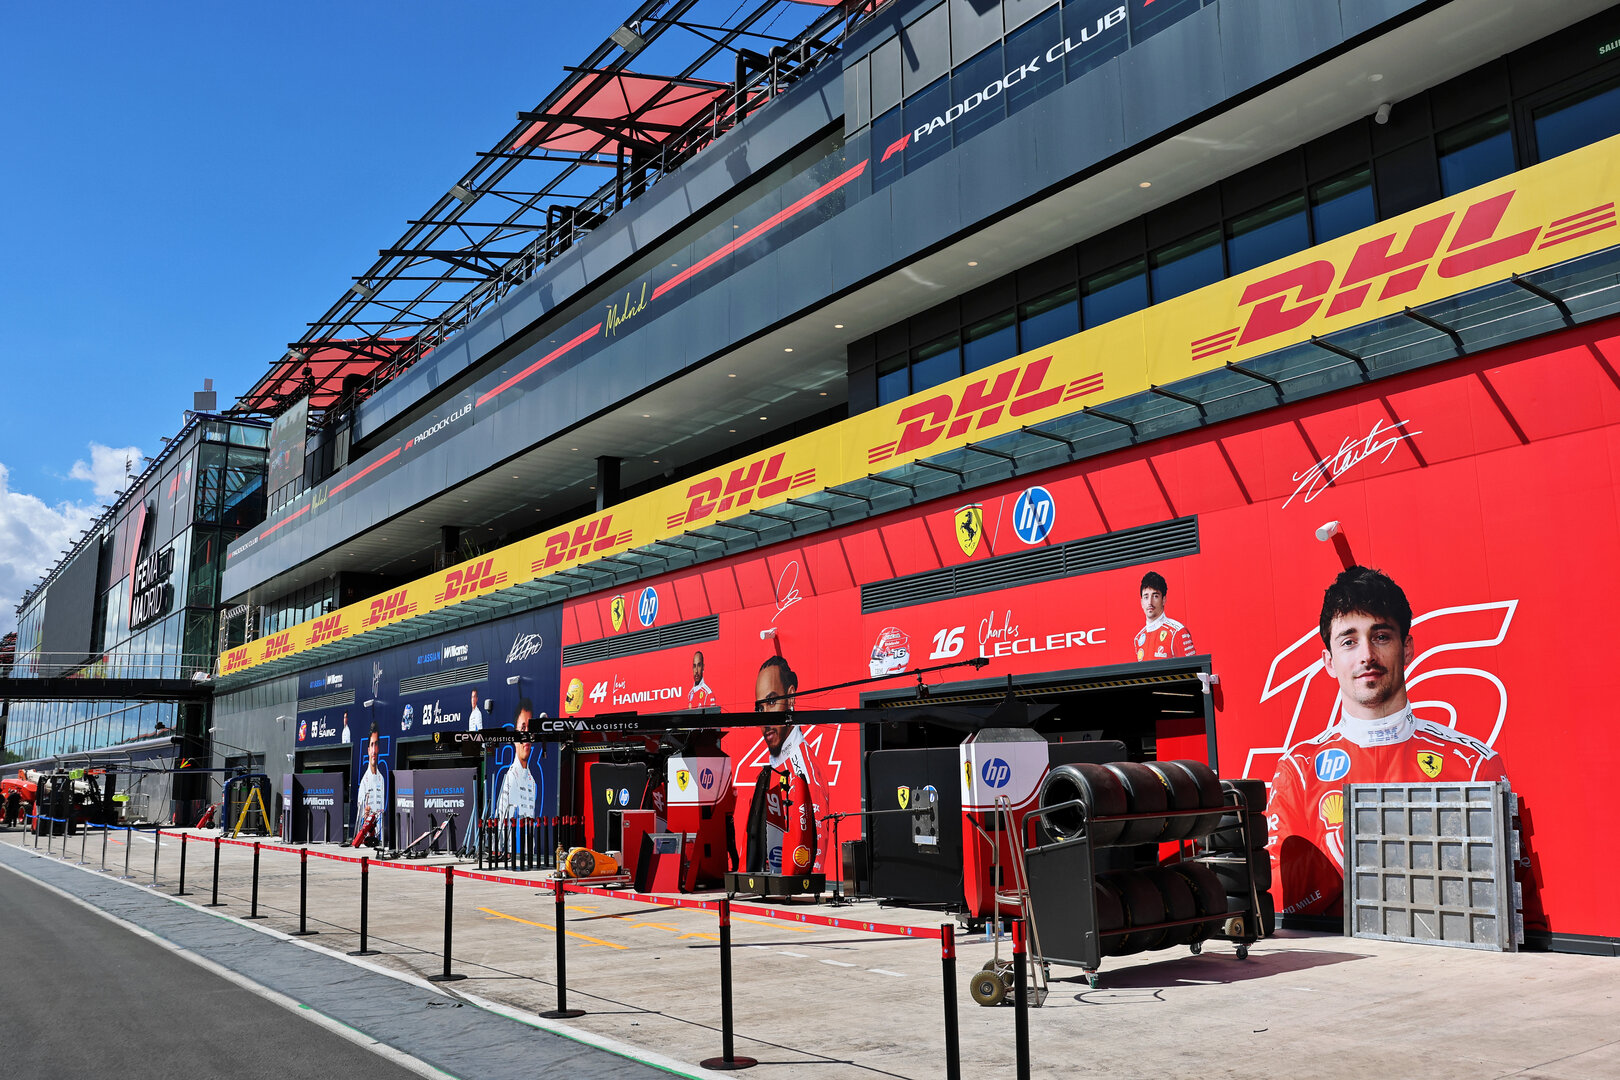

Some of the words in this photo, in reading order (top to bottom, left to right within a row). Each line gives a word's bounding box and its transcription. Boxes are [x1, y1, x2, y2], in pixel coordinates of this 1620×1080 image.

[1599, 39, 1620, 54] SALI
[914, 56, 1040, 143] PADDOCK
[1045, 5, 1126, 63] CLUB
[1236, 189, 1543, 347] DHL
[605, 282, 648, 337] Madrid
[895, 355, 1067, 456] DHL
[413, 418, 450, 446] PADDOCK
[450, 403, 472, 423] CLUB
[684, 452, 794, 524] DHL
[1019, 488, 1050, 544] hp
[543, 514, 619, 569] DHL
[444, 558, 497, 601] DHL
[131, 582, 165, 628] MADRID
[368, 589, 409, 625] DHL
[640, 588, 657, 626] hp
[311, 614, 342, 644] DHL
[929, 625, 966, 661] 16
[979, 628, 1107, 659] LECLERC
[978, 610, 1020, 646] Charles
[226, 648, 248, 671] DHL
[264, 632, 291, 659] DHL
[443, 644, 469, 659] Williams
[589, 681, 608, 704] 44
[613, 686, 682, 706] HAMILTON
[422, 704, 432, 725] 23
[434, 712, 461, 724] ALBON
[590, 722, 639, 730] LOGISTICS
[701, 768, 713, 789] hp
[984, 758, 1009, 788] hp
[1319, 750, 1346, 781] hp
[303, 797, 334, 806] Williams
[424, 797, 464, 808] Williams
[430, 787, 465, 795] ATLASSIAN
[766, 793, 782, 817] 16
[1296, 889, 1323, 911] MILLE
